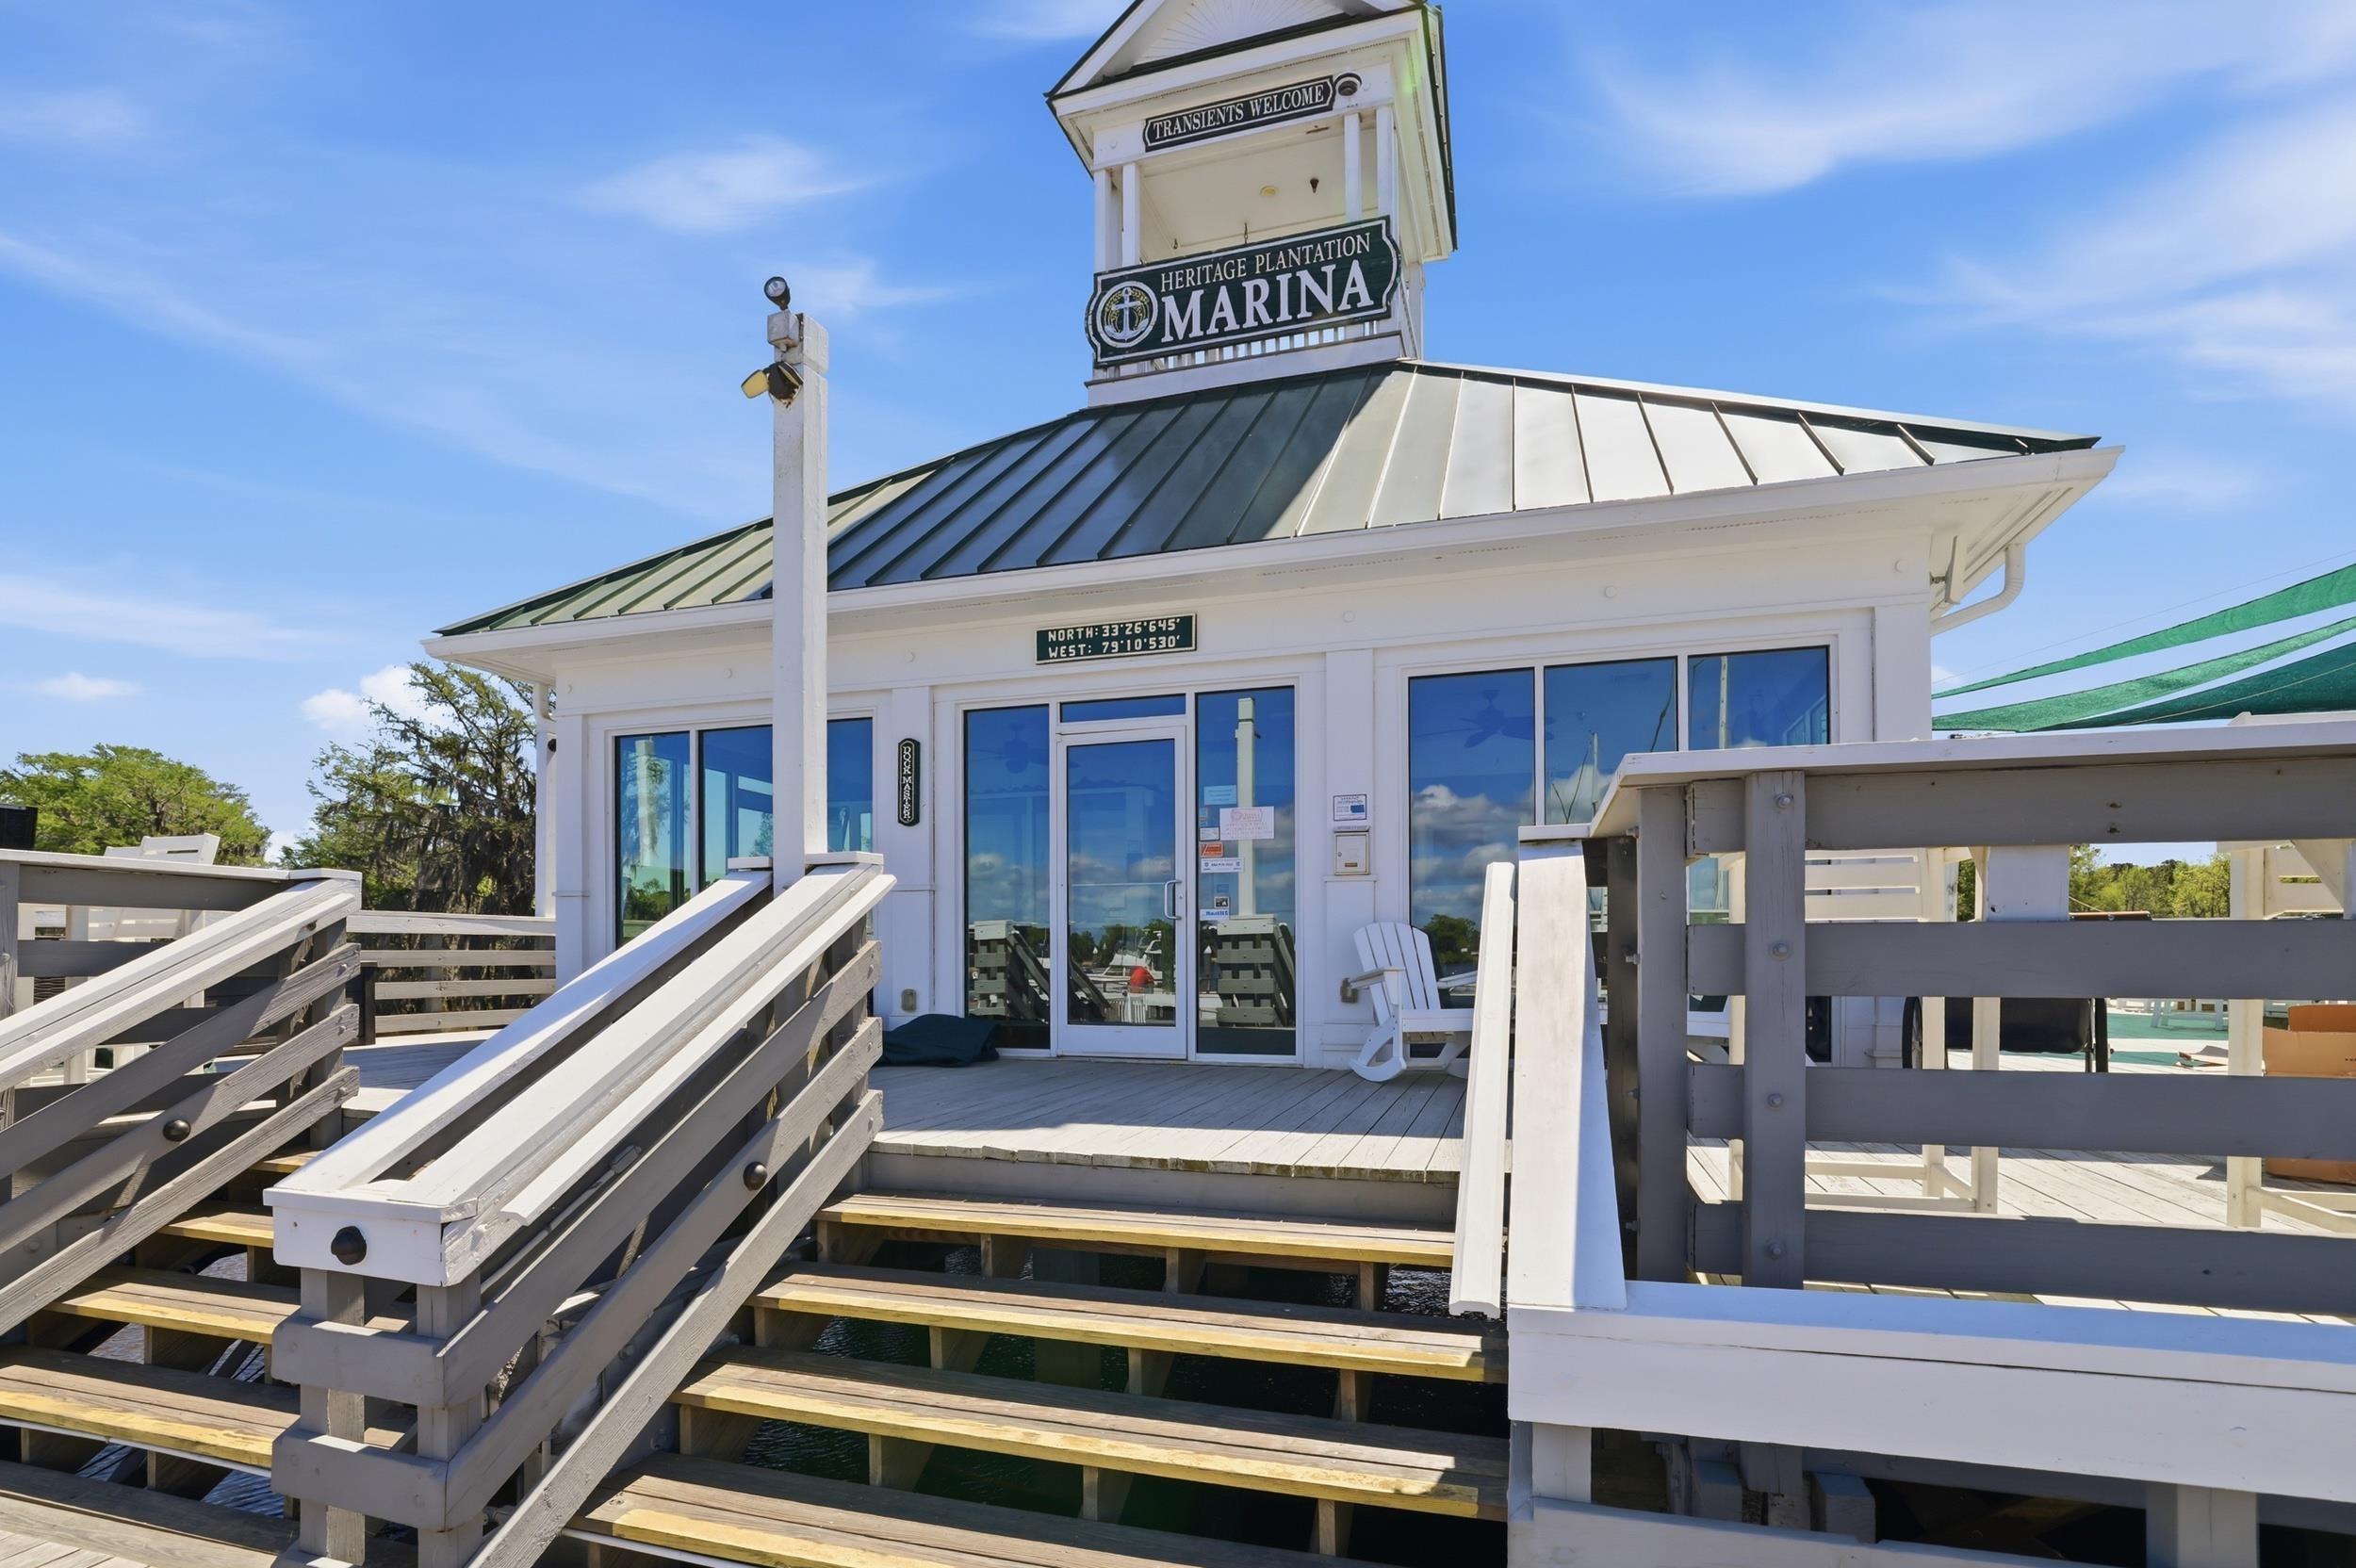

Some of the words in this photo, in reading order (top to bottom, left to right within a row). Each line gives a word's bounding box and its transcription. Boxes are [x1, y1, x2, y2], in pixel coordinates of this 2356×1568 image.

[1153, 102, 1245, 140] TRANSIENTS
[1249, 83, 1325, 118] WELCOME
[1160, 257, 1248, 293] HERITAGE
[1254, 232, 1371, 275] PLANTATION
[1160, 259, 1375, 343] MARINA
[1048, 626, 1100, 643] NORTH:
[1048, 644, 1092, 659] WEST:
[902, 745, 912, 775] DOCK
[902, 776, 912, 819] MASTER
